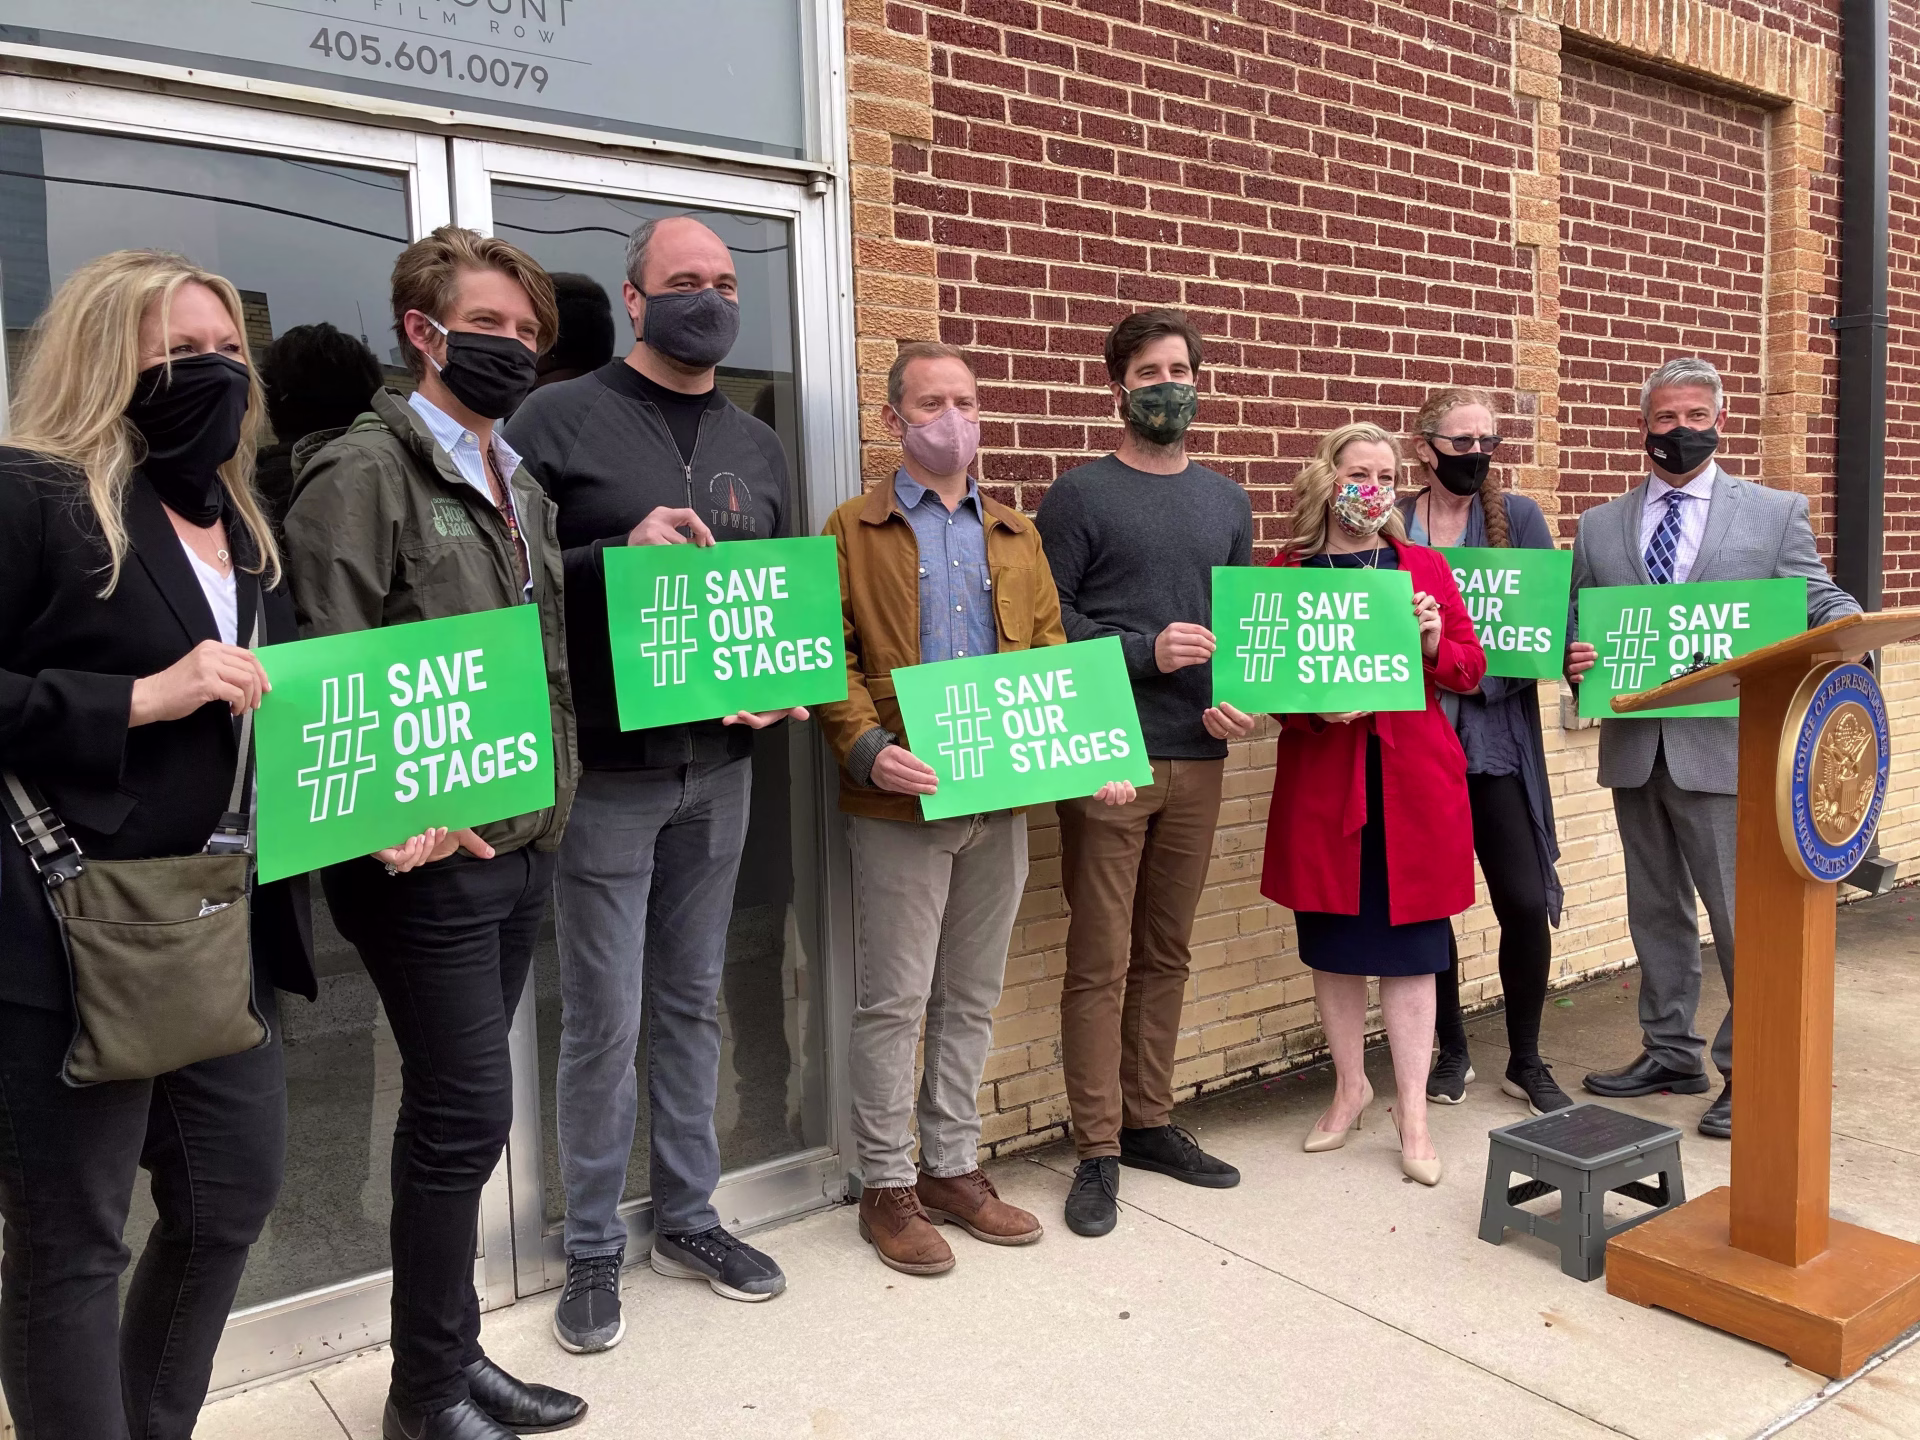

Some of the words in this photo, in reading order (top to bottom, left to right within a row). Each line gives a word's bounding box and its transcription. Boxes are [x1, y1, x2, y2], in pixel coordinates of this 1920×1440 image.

[374, 0, 456, 25] FILM
[490, 20, 554, 43] ROW
[309, 27, 549, 94] 405.601.0079
[710, 509, 756, 532] TOWER
[705, 566, 789, 605] SAVE
[1451, 568, 1521, 595] SAVE
[708, 605, 776, 643] OUR
[1297, 591, 1370, 620] SAVE
[1462, 596, 1503, 622] UR
[1668, 602, 1750, 631] SAVE
[1297, 623, 1356, 652] OUR
[1473, 624, 1552, 653] AGES
[1669, 633, 1733, 661] OUR
[387, 648, 487, 707] SAVE
[713, 636, 833, 681] STAGES
[1297, 654, 1410, 684] STAGES
[994, 668, 1077, 707] SAVE
[393, 701, 474, 756] OUR
[1001, 704, 1068, 740] OUR
[1796, 715, 1816, 784] HOUSE
[1814, 692, 1827, 716] OF
[394, 732, 539, 804] STAGES
[1009, 727, 1130, 773] STAGES
[1795, 792, 1816, 859] UNITED
[1813, 852, 1846, 874] STATES
[1847, 843, 1860, 865] OF
[1861, 766, 1888, 848] AMERICA
